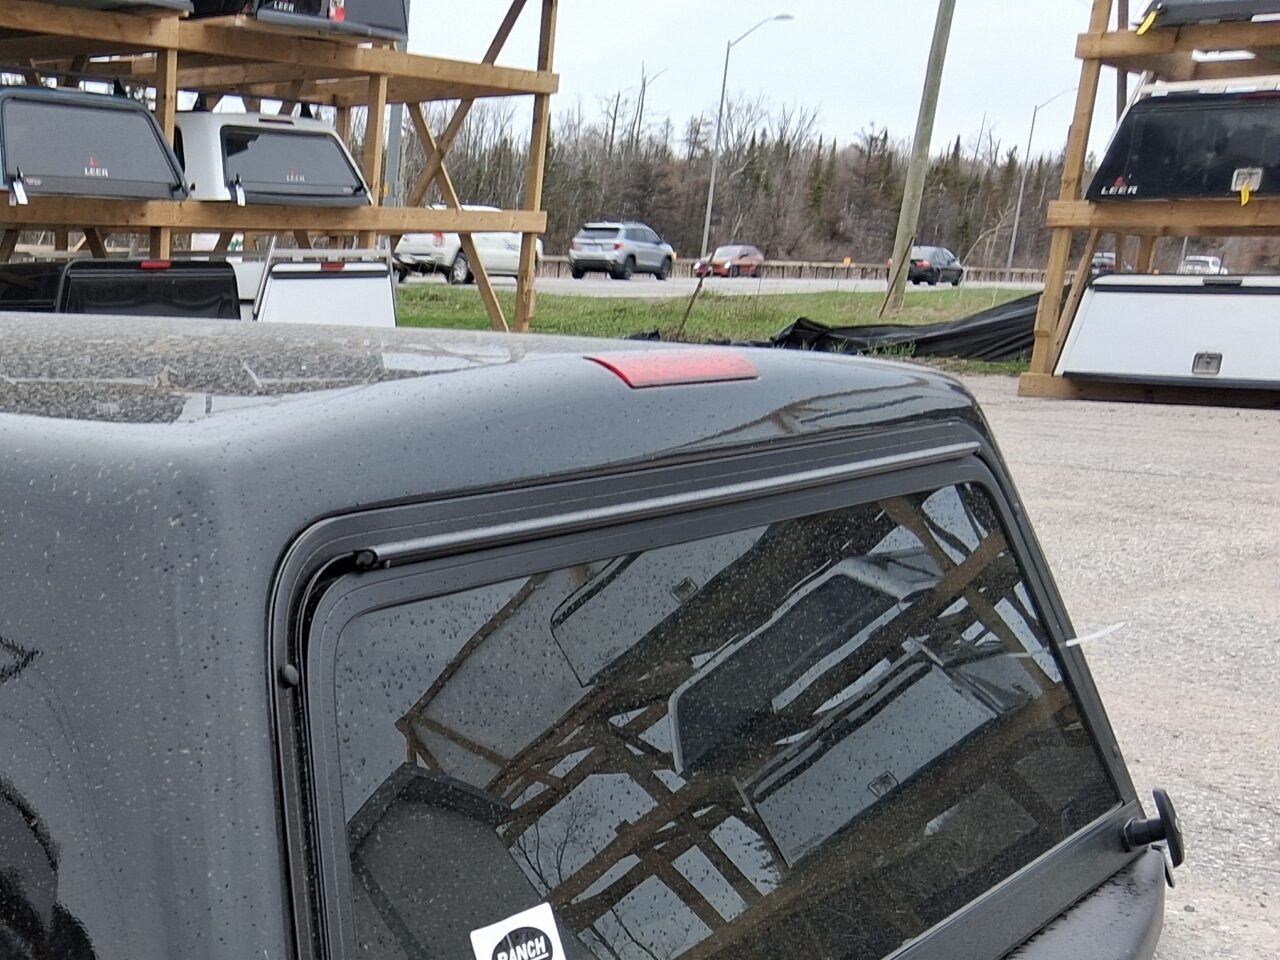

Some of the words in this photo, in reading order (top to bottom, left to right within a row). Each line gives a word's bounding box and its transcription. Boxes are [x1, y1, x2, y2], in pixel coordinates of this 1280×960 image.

[273, 0, 295, 13] LEER
[84, 165, 109, 178] LEER
[1100, 185, 1139, 195] LEER
